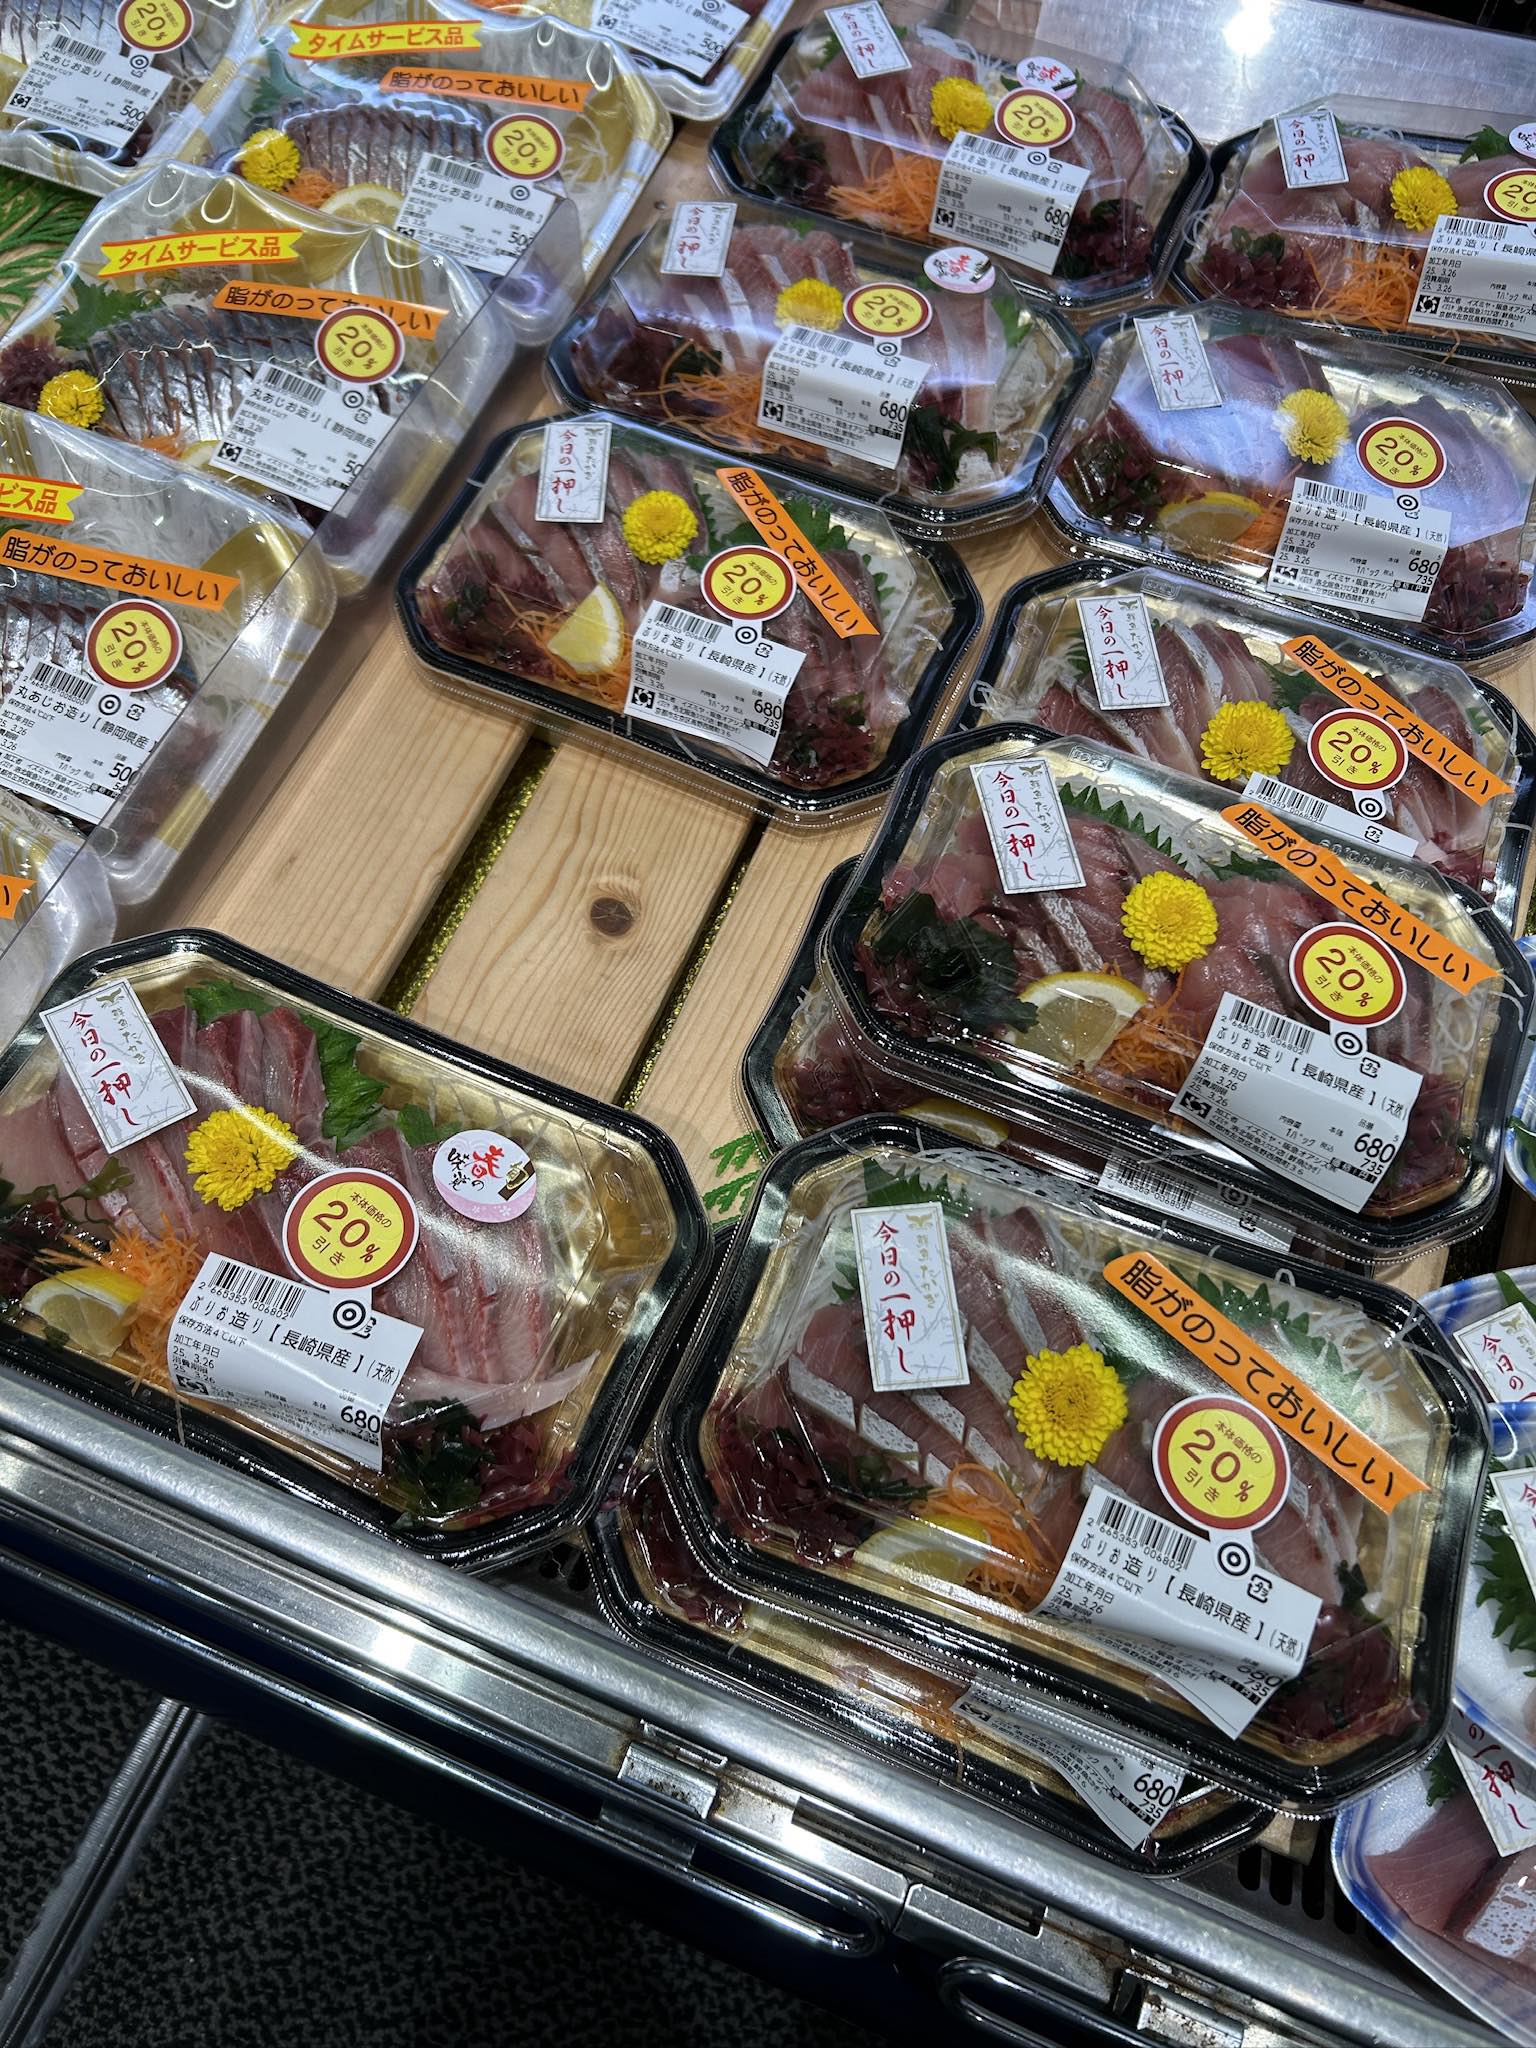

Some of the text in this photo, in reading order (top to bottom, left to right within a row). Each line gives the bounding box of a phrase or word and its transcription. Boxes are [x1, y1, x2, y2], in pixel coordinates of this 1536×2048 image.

[137, 3, 168, 41] 20%
[307, 27, 464, 54] タイムサービス品
[389, 71, 580, 104] 脂がのっておいしい
[120, 105, 146, 121] 500
[1012, 104, 1052, 138] 20%
[502, 129, 541, 168] 20%
[1290, 120, 1315, 180] 今日の一押し
[1044, 206, 1070, 228] 680
[119, 236, 281, 269] タイムサービス品
[862, 296, 907, 328] 20%
[335, 326, 378, 370] 20%
[1151, 325, 1186, 402] 今日の一押し
[879, 401, 907, 423] 680
[552, 429, 577, 513] 今日の一押し
[1375, 437, 1423, 475] 20%
[2, 537, 219, 600] 脂がのっておいしい
[727, 472, 858, 631] 脂がのっておいしい
[1408, 558, 1440, 575] 680
[722, 564, 769, 606] 20%
[1416, 575, 1433, 585] 735
[111, 621, 148, 673] 20%
[1095, 605, 1128, 700] 今日の一押し
[754, 699, 782, 720] 680
[763, 717, 780, 729] 735
[1294, 640, 1488, 795] 脂がのっておいしい
[1328, 730, 1381, 774] 20%
[1352, 725, 1387, 752] 本体価格の
[1331, 755, 1359, 774] 引き
[992, 771, 1036, 881] 今日の一押し
[1234, 808, 1470, 982] 脂がのっておいしい
[1315, 949, 1374, 1008] 20%
[1347, 946, 1384, 984] 本体価格の
[1315, 975, 1344, 1002] 引き
[1232, 1020, 1266, 1039] 665353
[1270, 1037, 1305, 1055] 006802
[68, 1011, 141, 1126] 今日の一押し
[1202, 1056, 1248, 1082] 加工年月日
[1216, 1076, 1238, 1091] 3.26
[1208, 1092, 1228, 1107] 3.26
[1354, 1133, 1396, 1163] 680
[1361, 1158, 1384, 1176] 735
[350, 1191, 393, 1228] 本体価格の
[313, 1200, 380, 1262] 20%
[312, 1236, 345, 1266] 引き
[198, 1281, 289, 1321] 2 665353 006802
[873, 1220, 916, 1375] 今日の一押し
[174, 1334, 220, 1358] 加工年月日
[178, 1315, 247, 1347] 保存方法4℃以下
[194, 1354, 215, 1369] 3.26
[1120, 1259, 1394, 1498] 脂がのっておいしい
[340, 1405, 380, 1433] 680
[1216, 1420, 1263, 1464] 本体価格の
[1182, 1429, 1256, 1503] 20%
[1184, 1467, 1220, 1502] 引き
[1087, 1517, 1183, 1573] 2 665353 006802
[1064, 1571, 1115, 1605] 加工年月日
[1070, 1552, 1144, 1595] 保存方法4℃以下
[1080, 1596, 1103, 1615] 3.26
[1244, 1677, 1272, 1697] 735
[1133, 1773, 1176, 1807] 680
[1139, 1799, 1164, 1819] 735
